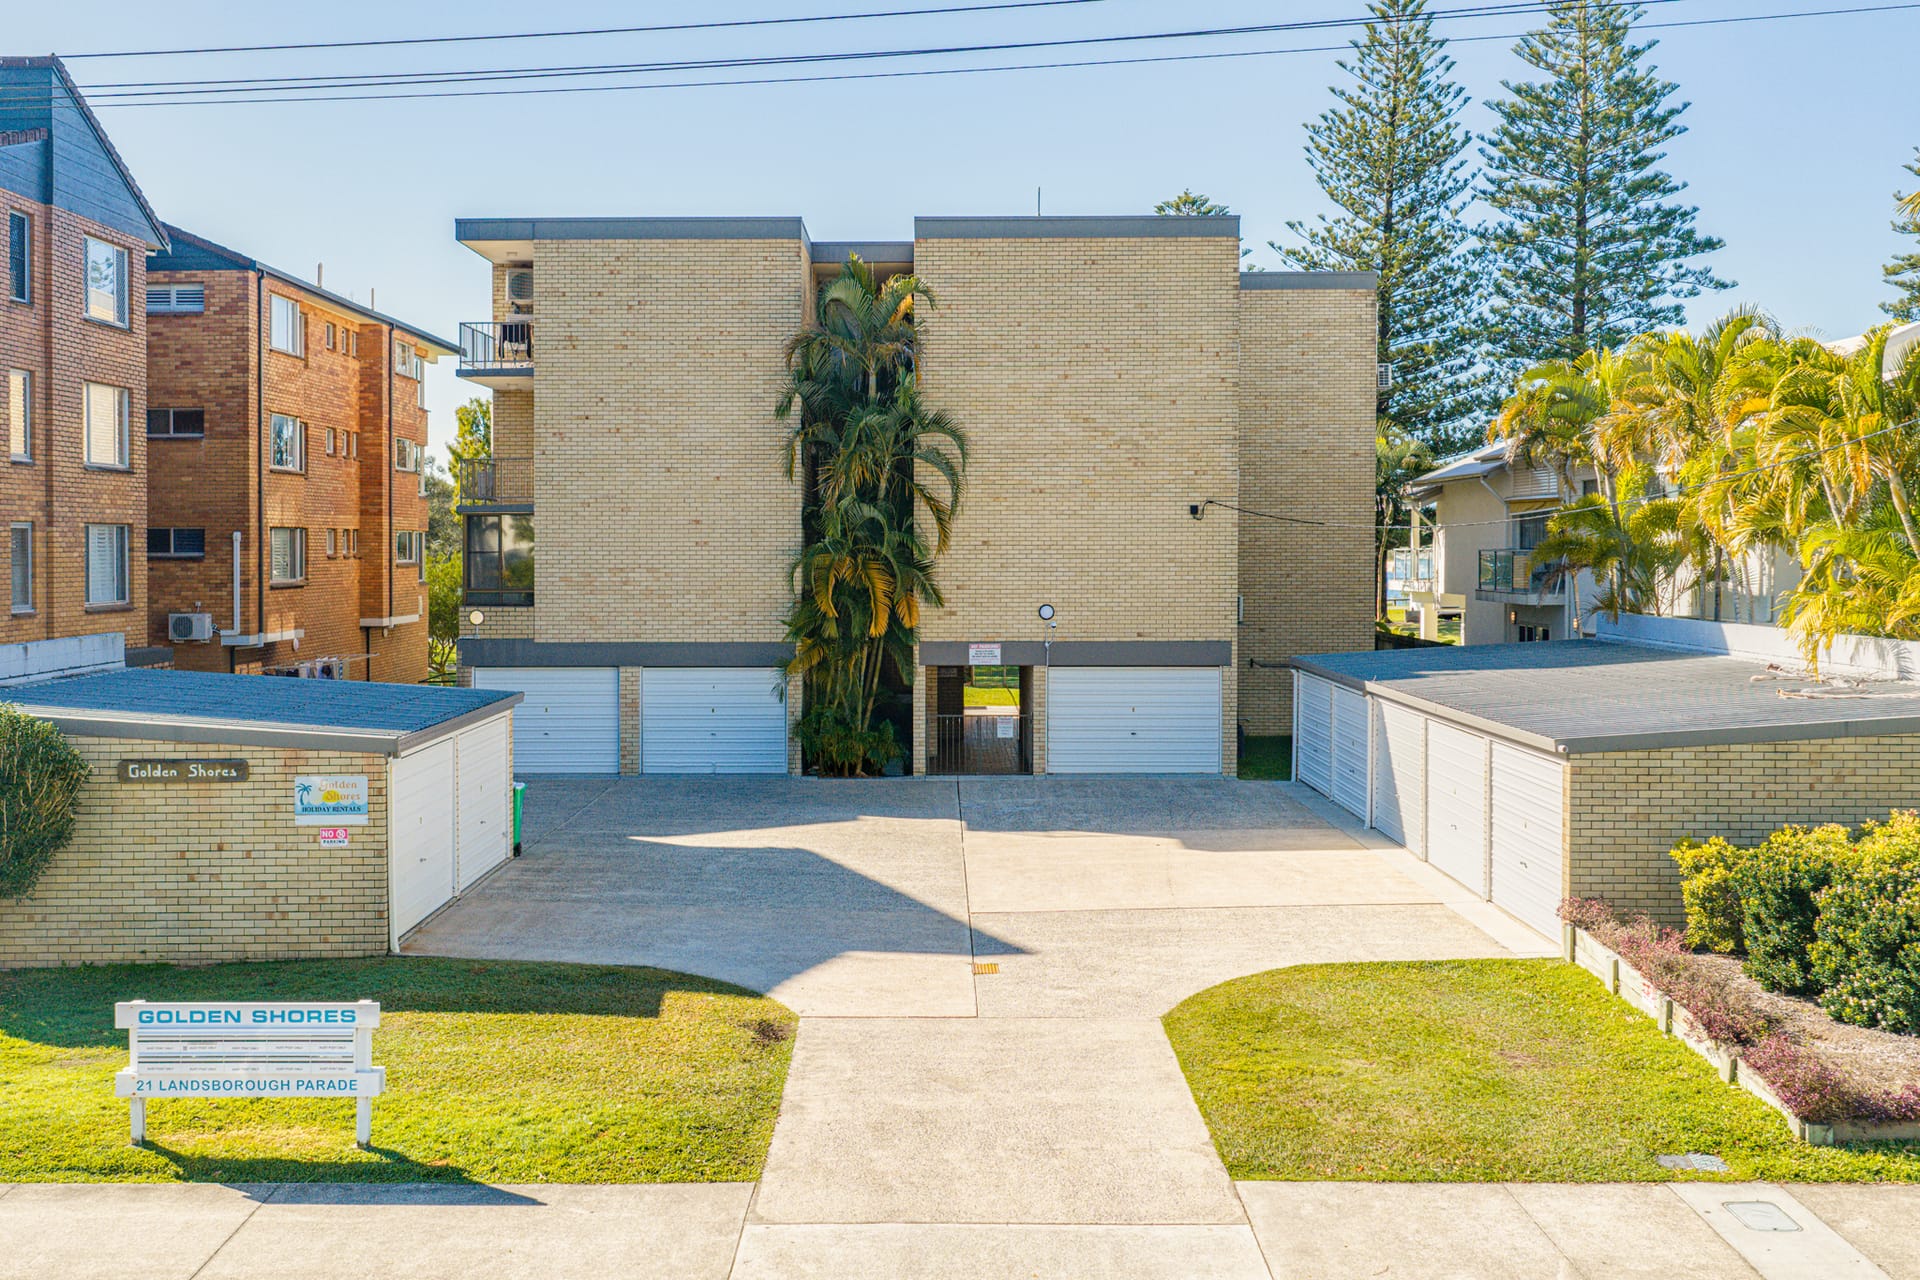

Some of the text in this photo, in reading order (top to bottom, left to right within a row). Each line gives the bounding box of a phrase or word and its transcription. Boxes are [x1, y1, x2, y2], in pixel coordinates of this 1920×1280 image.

[128, 764, 238, 778] Golden Shores
[318, 779, 357, 792] Golden
[326, 790, 361, 801] Shores
[321, 830, 335, 838] NO
[138, 1009, 357, 1024] GOLDEN SHORES
[136, 1079, 359, 1092] 21 LANDSBOROUGH PARADE
